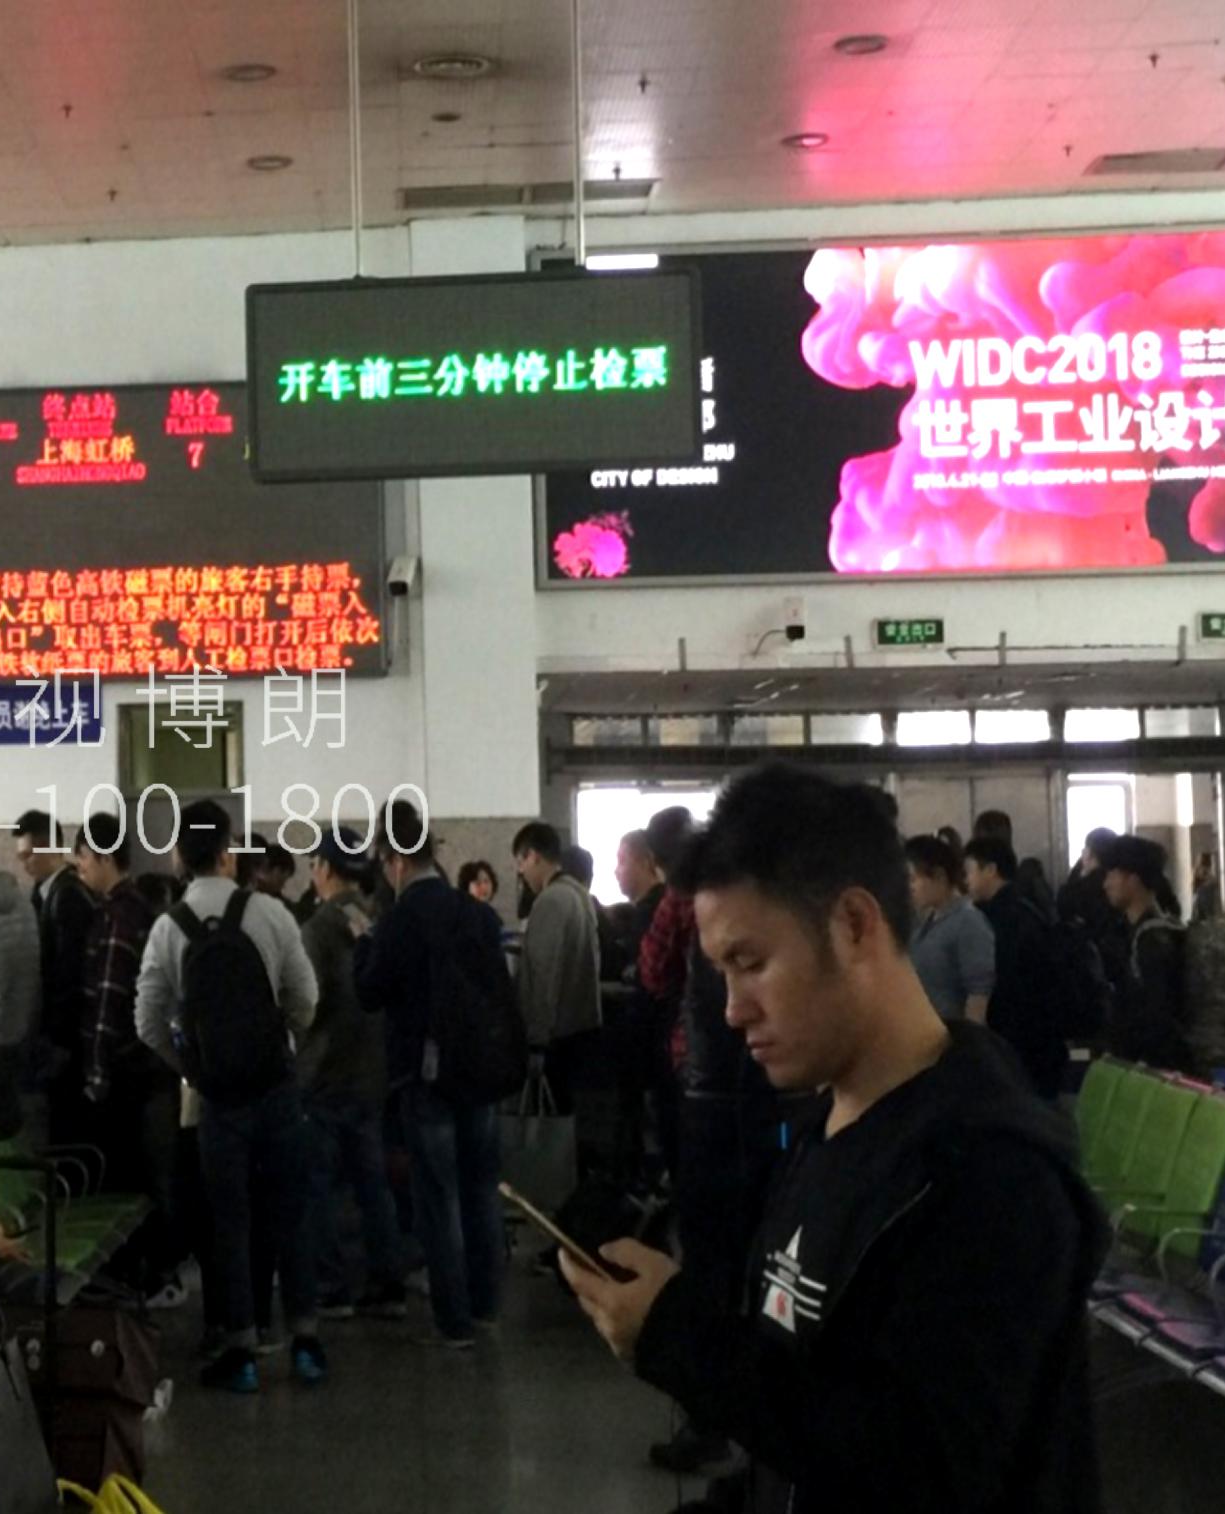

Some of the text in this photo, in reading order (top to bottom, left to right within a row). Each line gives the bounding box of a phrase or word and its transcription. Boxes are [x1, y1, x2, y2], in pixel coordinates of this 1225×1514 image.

[278, 344, 668, 402] 开车前三分钟停止检票
[908, 331, 1163, 390] WIDC2018
[43, 393, 115, 420] 终点站
[170, 389, 219, 417] 站台
[36, 435, 135, 464] 上海虹桥
[188, 442, 204, 468] 7
[590, 470, 628, 488] CITY
[631, 469, 653, 486] OF
